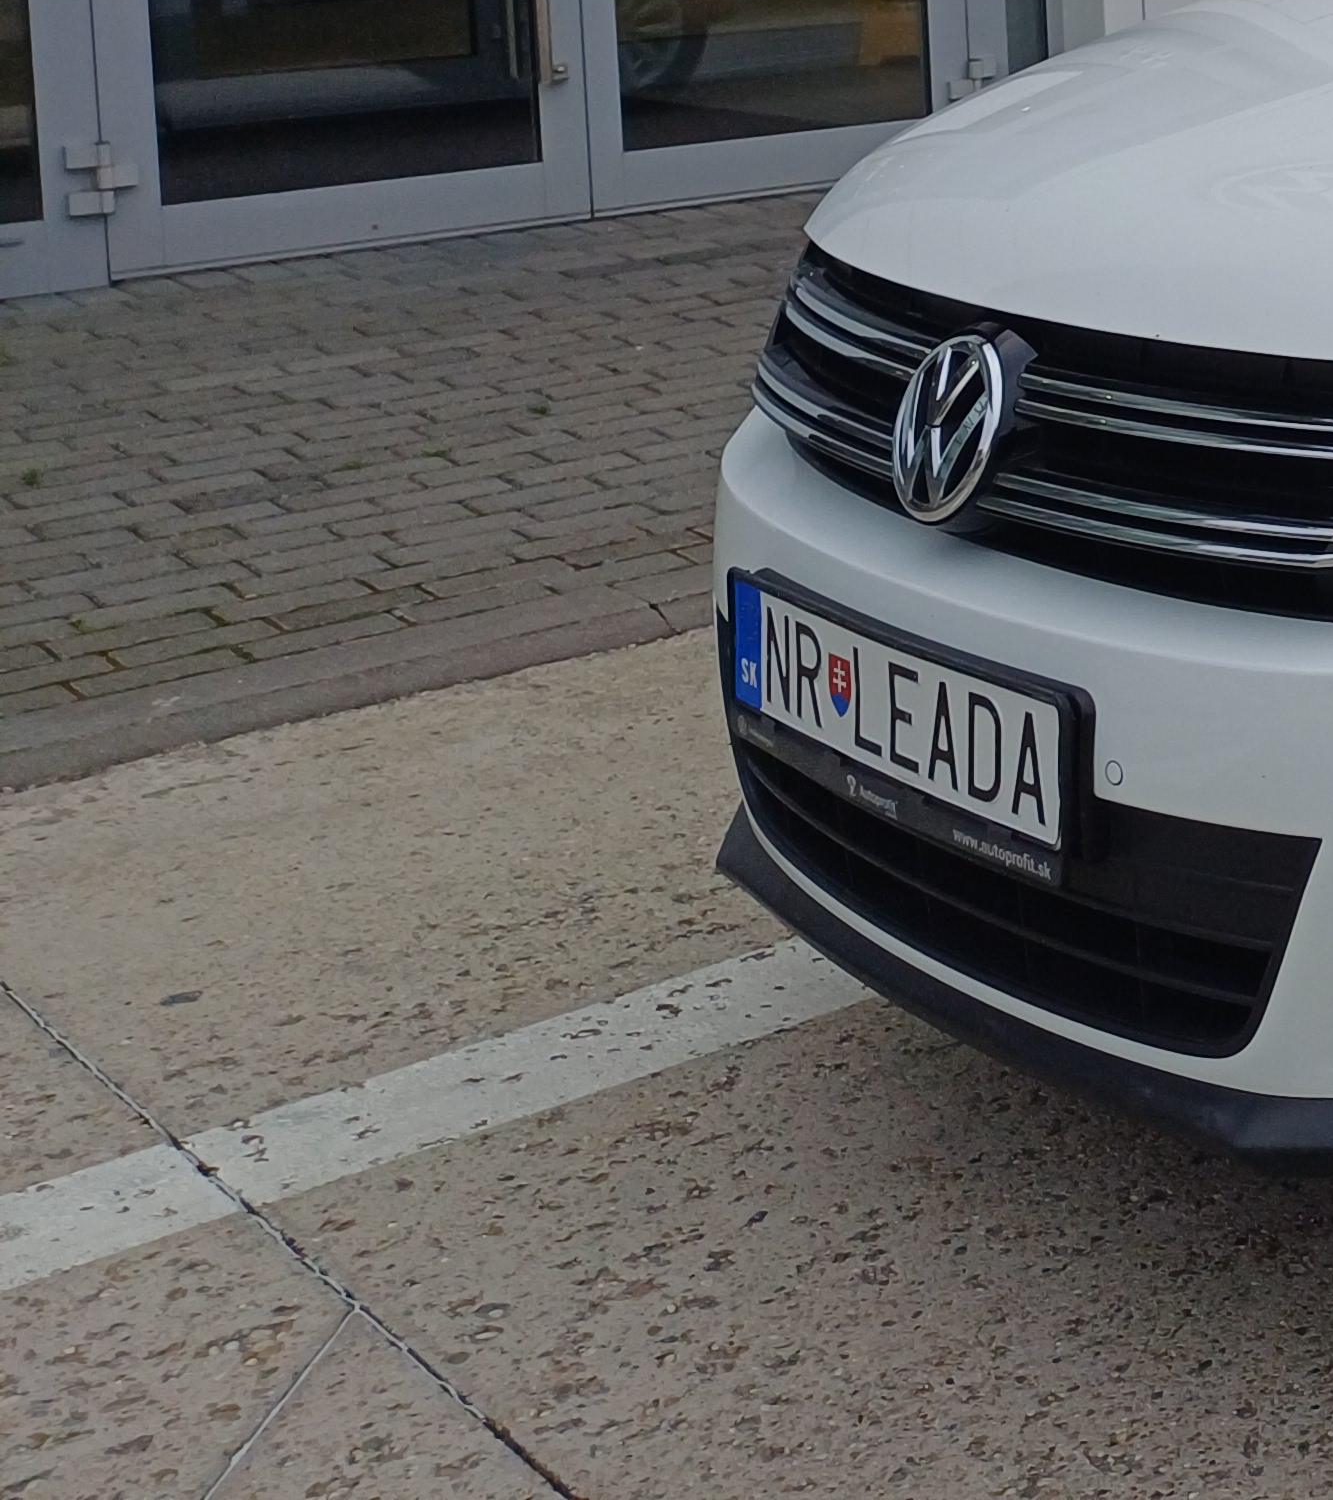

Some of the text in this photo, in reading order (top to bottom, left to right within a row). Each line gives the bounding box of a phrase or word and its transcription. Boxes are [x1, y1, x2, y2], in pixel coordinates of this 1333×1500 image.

[741, 657, 758, 689] SK
[766, 605, 1047, 828] NR LEADA
[952, 829, 1051, 880] www.autoprofit.sk
